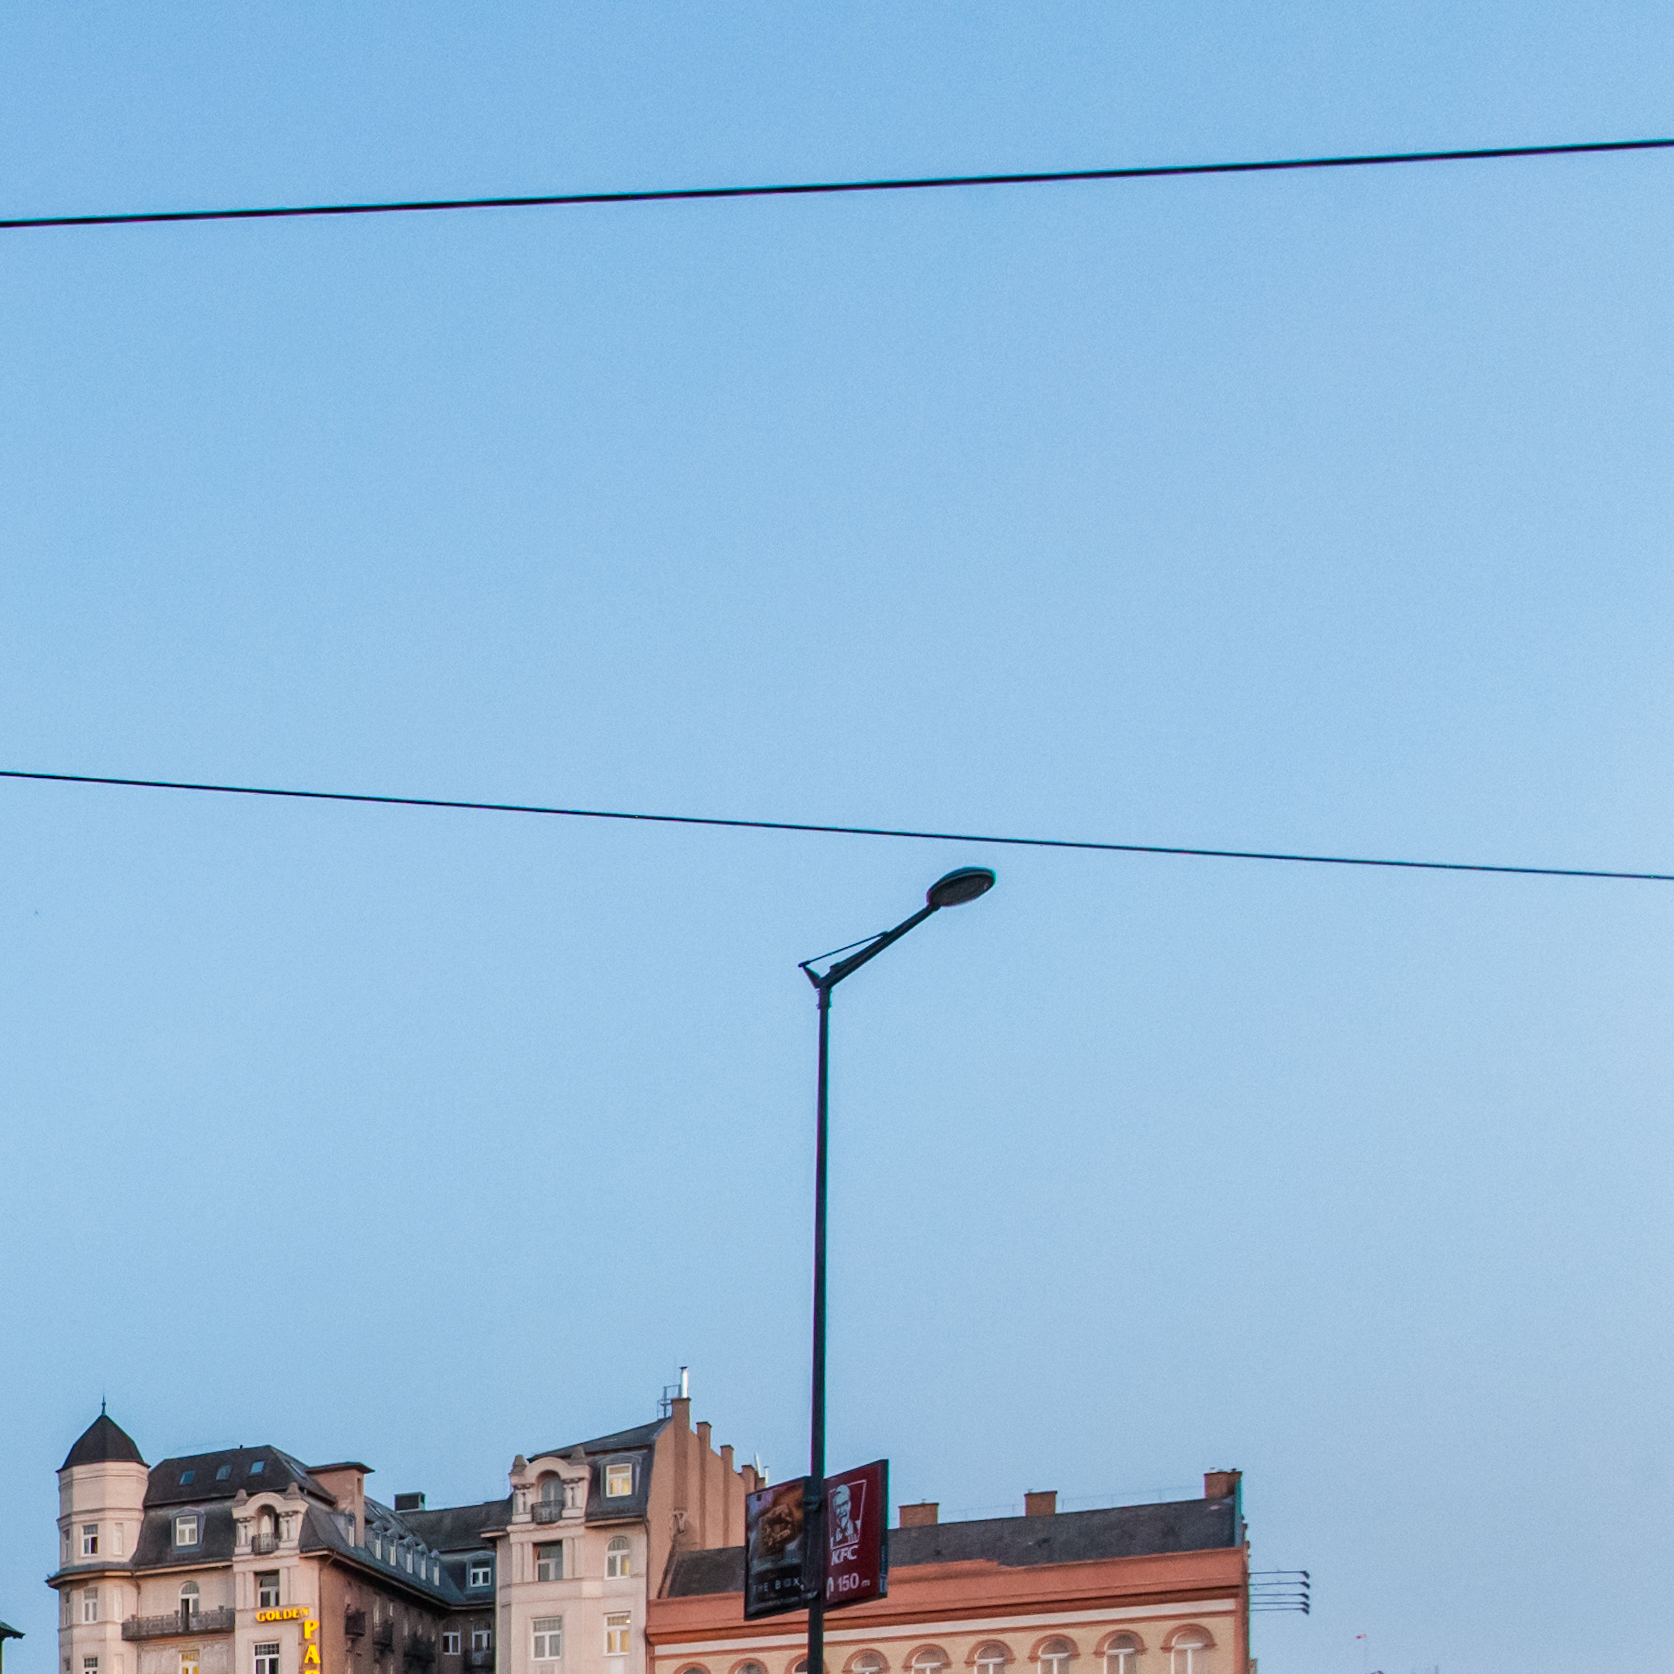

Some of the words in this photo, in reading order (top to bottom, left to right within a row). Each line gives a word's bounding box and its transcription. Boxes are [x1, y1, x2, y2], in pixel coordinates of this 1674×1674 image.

[831, 1545, 859, 1566] KFC
[752, 1582, 769, 1595] THE
[837, 1573, 860, 1593] 150
[255, 1607, 310, 1622] GOLDEN
